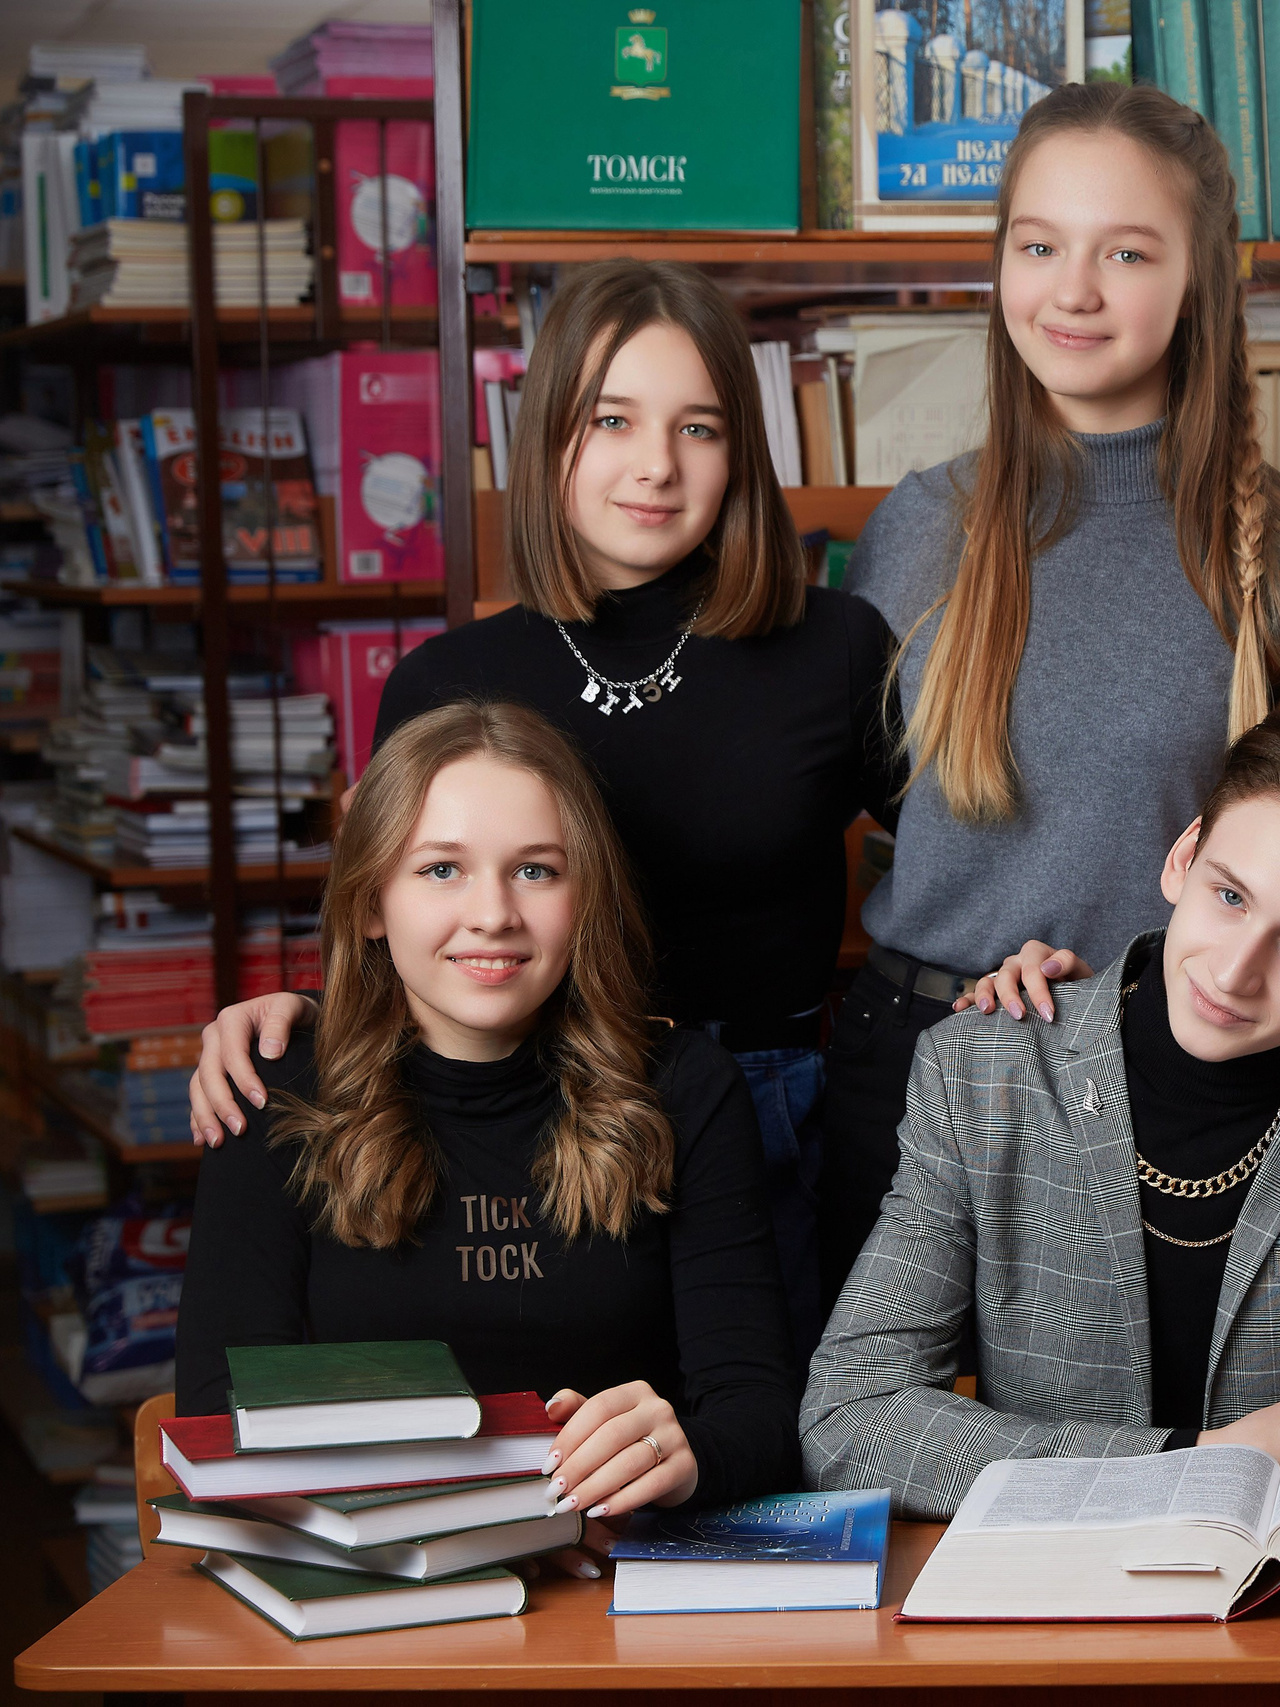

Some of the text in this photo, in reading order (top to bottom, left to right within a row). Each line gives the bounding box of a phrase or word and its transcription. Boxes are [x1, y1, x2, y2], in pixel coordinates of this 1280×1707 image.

[587, 153, 688, 182] ТОМСК
[942, 163, 1002, 187] НЕДЕ
[166, 427, 294, 450] ENLISH
[459, 1194, 532, 1234] TICK
[455, 1241, 545, 1282] TOCK
